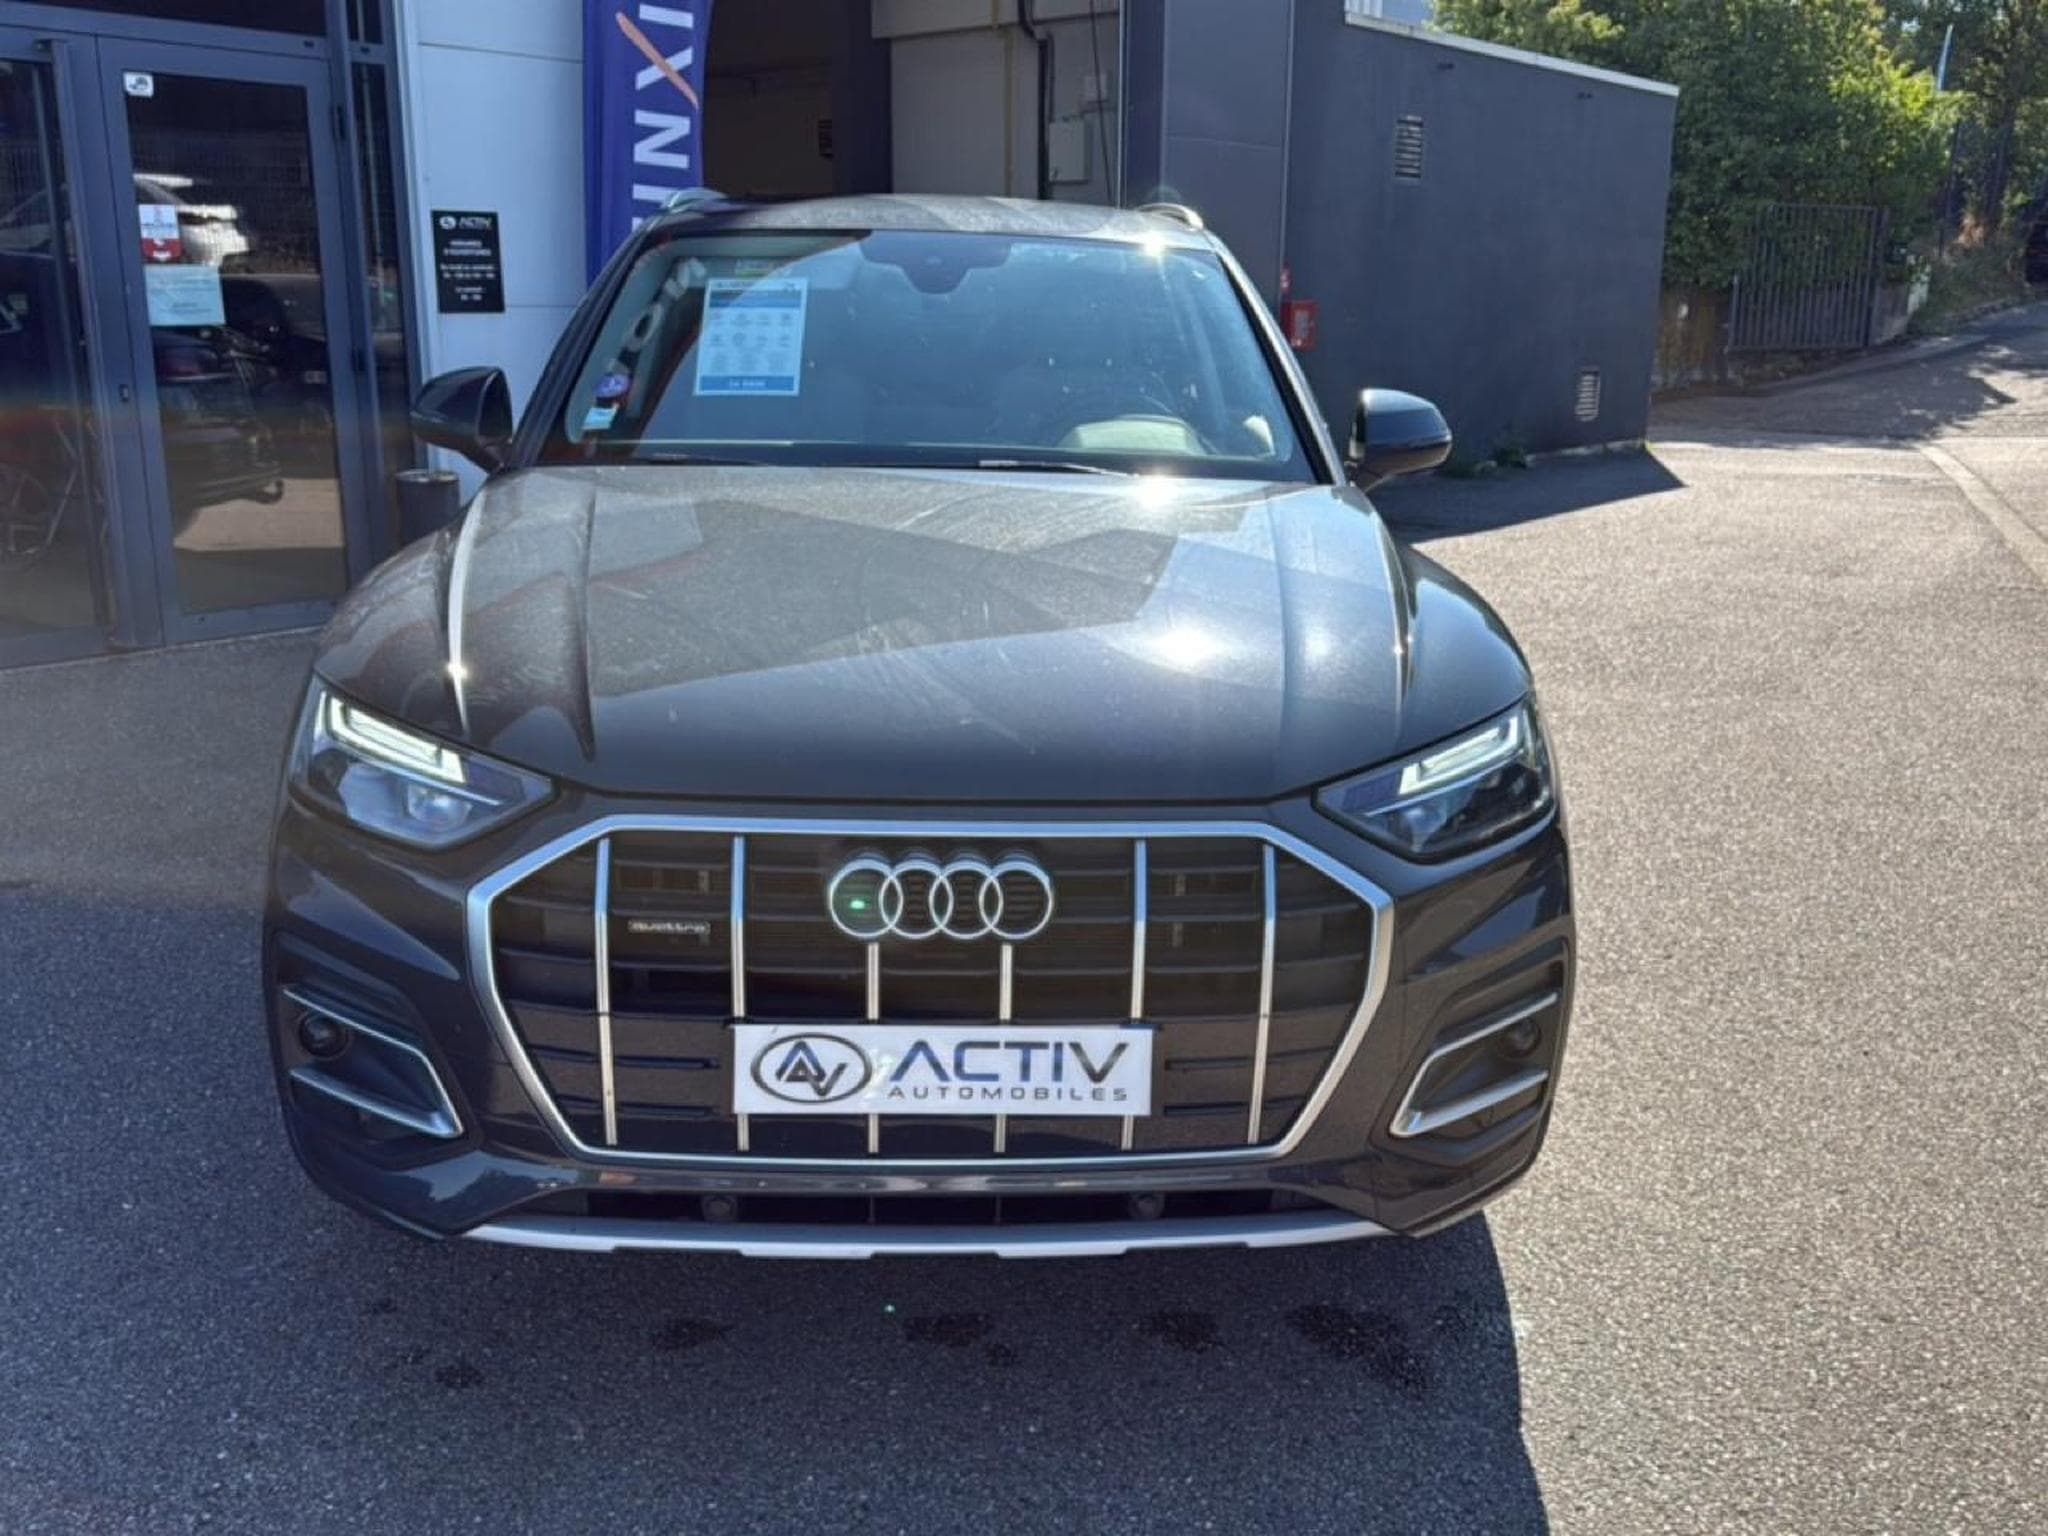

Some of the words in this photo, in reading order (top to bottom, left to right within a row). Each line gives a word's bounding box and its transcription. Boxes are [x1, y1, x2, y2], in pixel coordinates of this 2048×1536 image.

[616, 4, 699, 232] INXI
[889, 1040, 1129, 1083] ACTIV
[887, 1086, 1128, 1101] AUTOMOBILES
